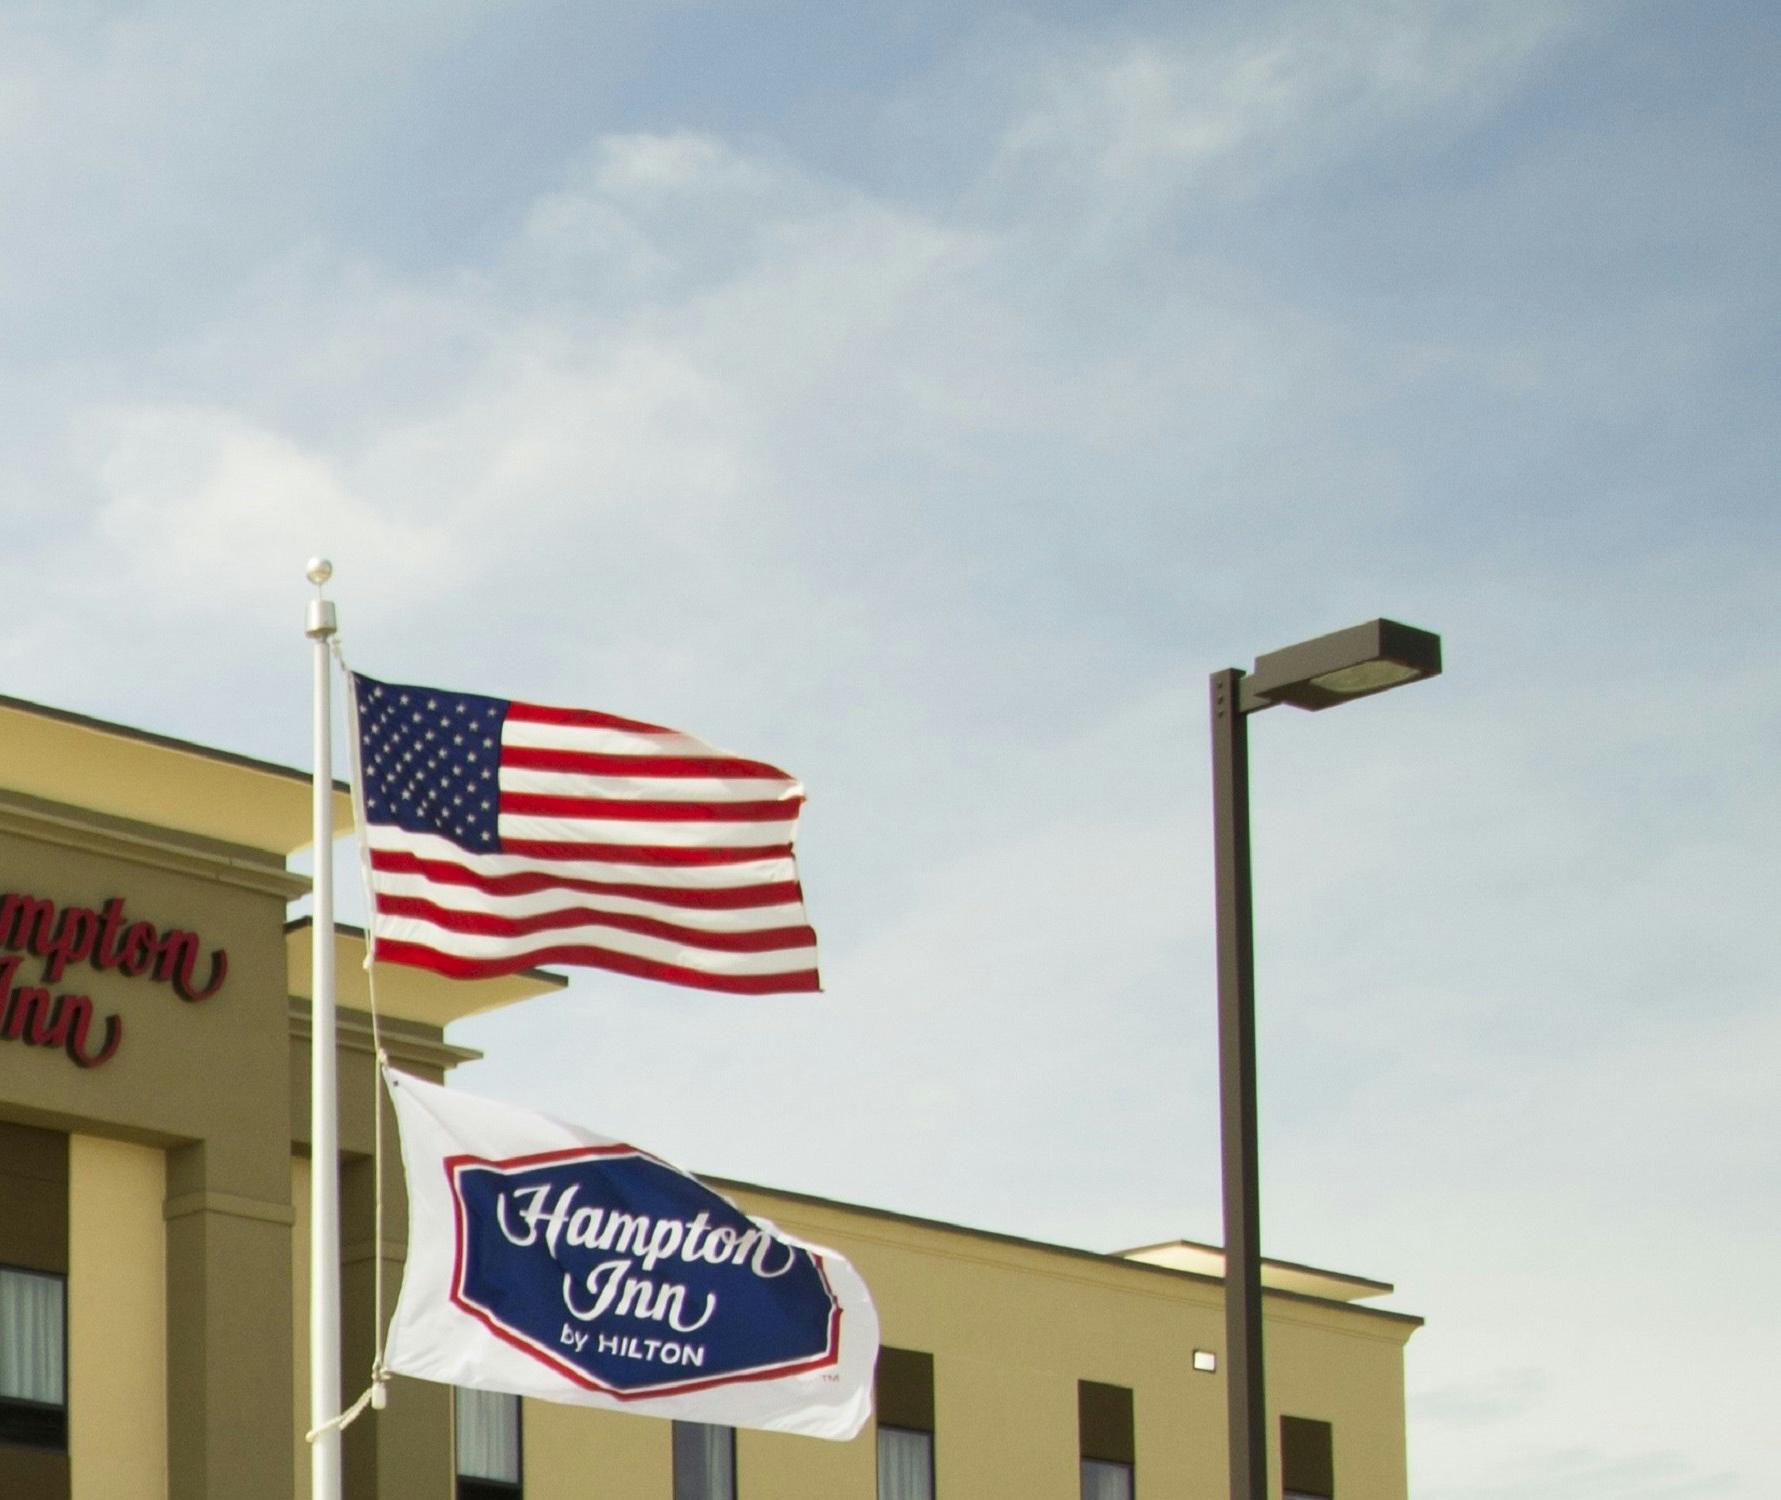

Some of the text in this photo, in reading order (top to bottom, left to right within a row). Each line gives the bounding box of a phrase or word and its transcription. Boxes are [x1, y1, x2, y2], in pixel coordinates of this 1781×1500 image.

[497, 1183, 795, 1278] Hampton
[564, 1260, 716, 1333] Inn
[560, 1323, 705, 1367] by HILTON
